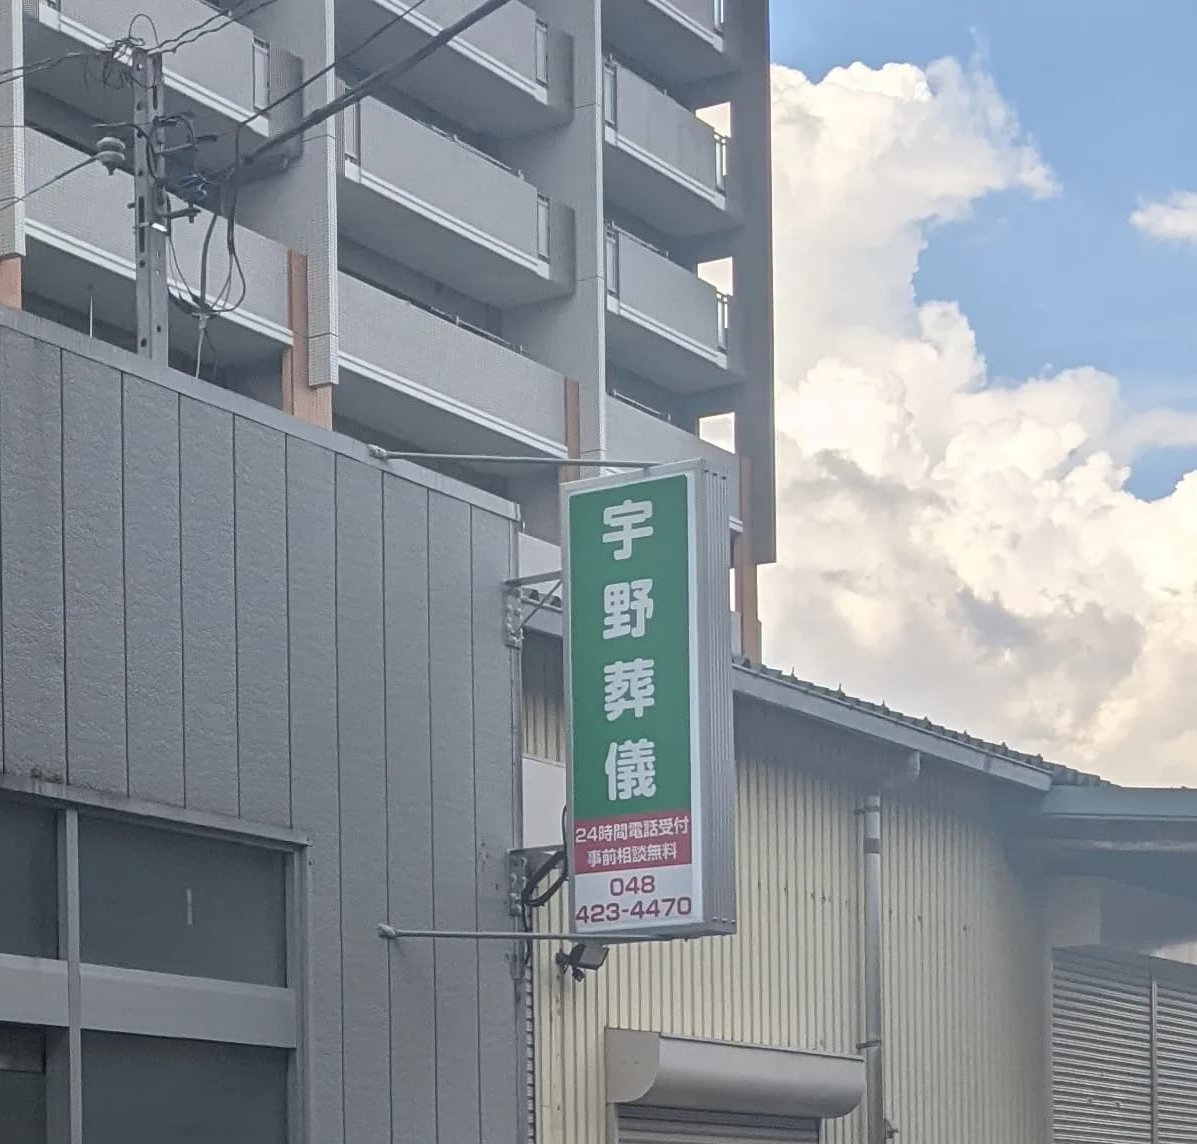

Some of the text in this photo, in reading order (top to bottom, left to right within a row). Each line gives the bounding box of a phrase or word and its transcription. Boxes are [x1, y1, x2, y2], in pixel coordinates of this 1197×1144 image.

[602, 499, 656, 801] 宇野葬儀
[575, 816, 690, 843] 24時間電話受付
[587, 842, 677, 867] 事前相談無料
[610, 875, 655, 896] 048
[576, 897, 692, 923] 423-4470
